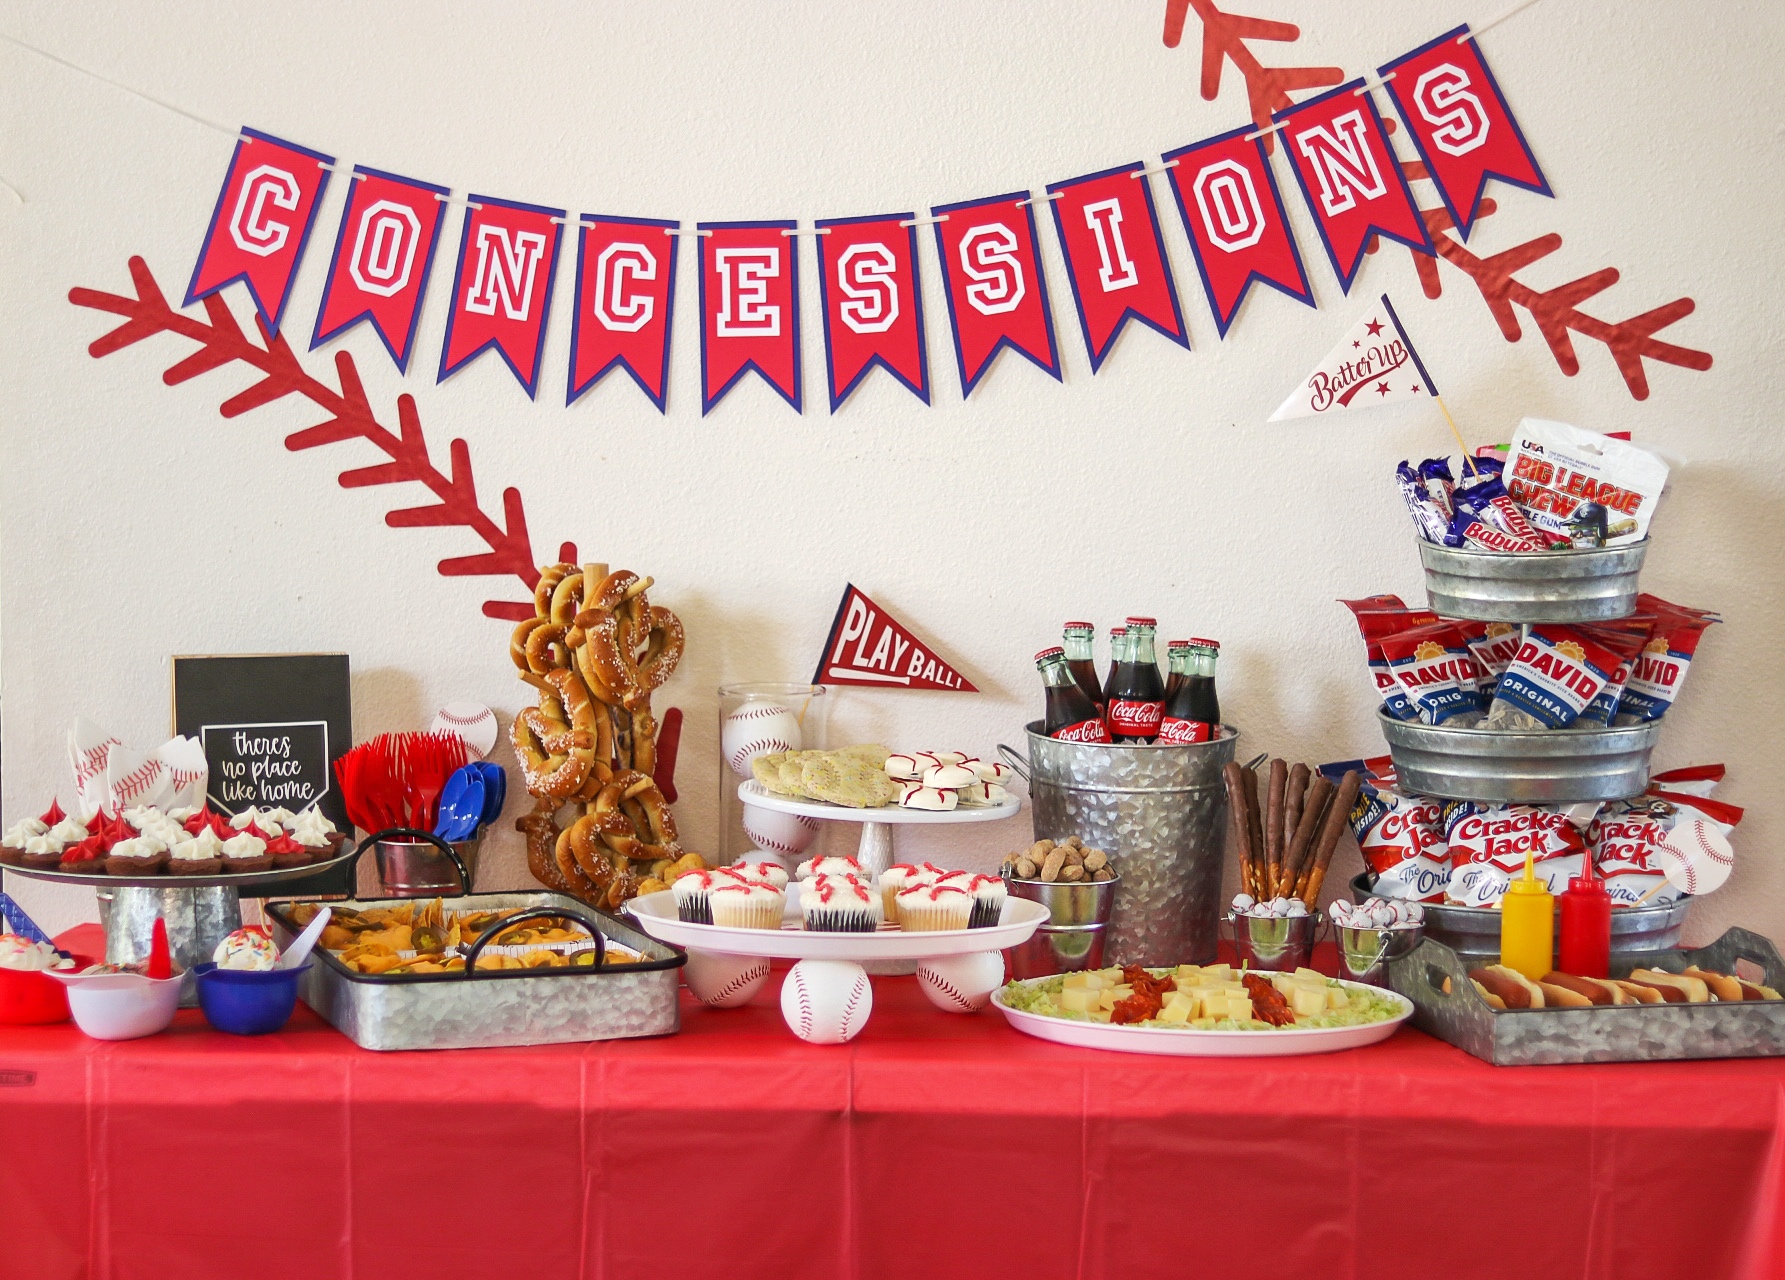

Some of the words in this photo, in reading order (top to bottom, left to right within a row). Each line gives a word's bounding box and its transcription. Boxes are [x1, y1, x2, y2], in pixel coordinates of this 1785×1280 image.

[229, 61, 1491, 337] CONCESSIONS
[1308, 357, 1372, 411] Batter
[1367, 340, 1408, 368] Up
[1509, 478, 1580, 519] CHEW
[1512, 453, 1555, 486] BIG
[1554, 467, 1643, 516] LEAGUE
[1495, 496, 1546, 549] BabyR
[1520, 508, 1540, 521] BLE
[1540, 515, 1561, 530] GUM
[1468, 524, 1537, 551] BabyR
[831, 594, 910, 672] PLAY
[907, 648, 962, 689] BALL!
[1475, 636, 1521, 664] DAV
[1398, 659, 1474, 688] DAVID
[1515, 643, 1598, 700] DAVID
[1633, 657, 1679, 686] AVID
[1112, 702, 1161, 722] Coca-Cola
[1504, 679, 1569, 722] ORIGINAL
[232, 731, 291, 758] theres
[1160, 718, 1200, 742] ca-Cola
[222, 760, 246, 779] no
[251, 756, 301, 785] place
[222, 780, 256, 801] like
[261, 780, 314, 802] home
[1380, 805, 1440, 840] Crac
[1459, 811, 1567, 840] Cracke
[1585, 819, 1667, 847] Cracke
[1472, 831, 1549, 864] Jack
[1399, 863, 1420, 885] The
